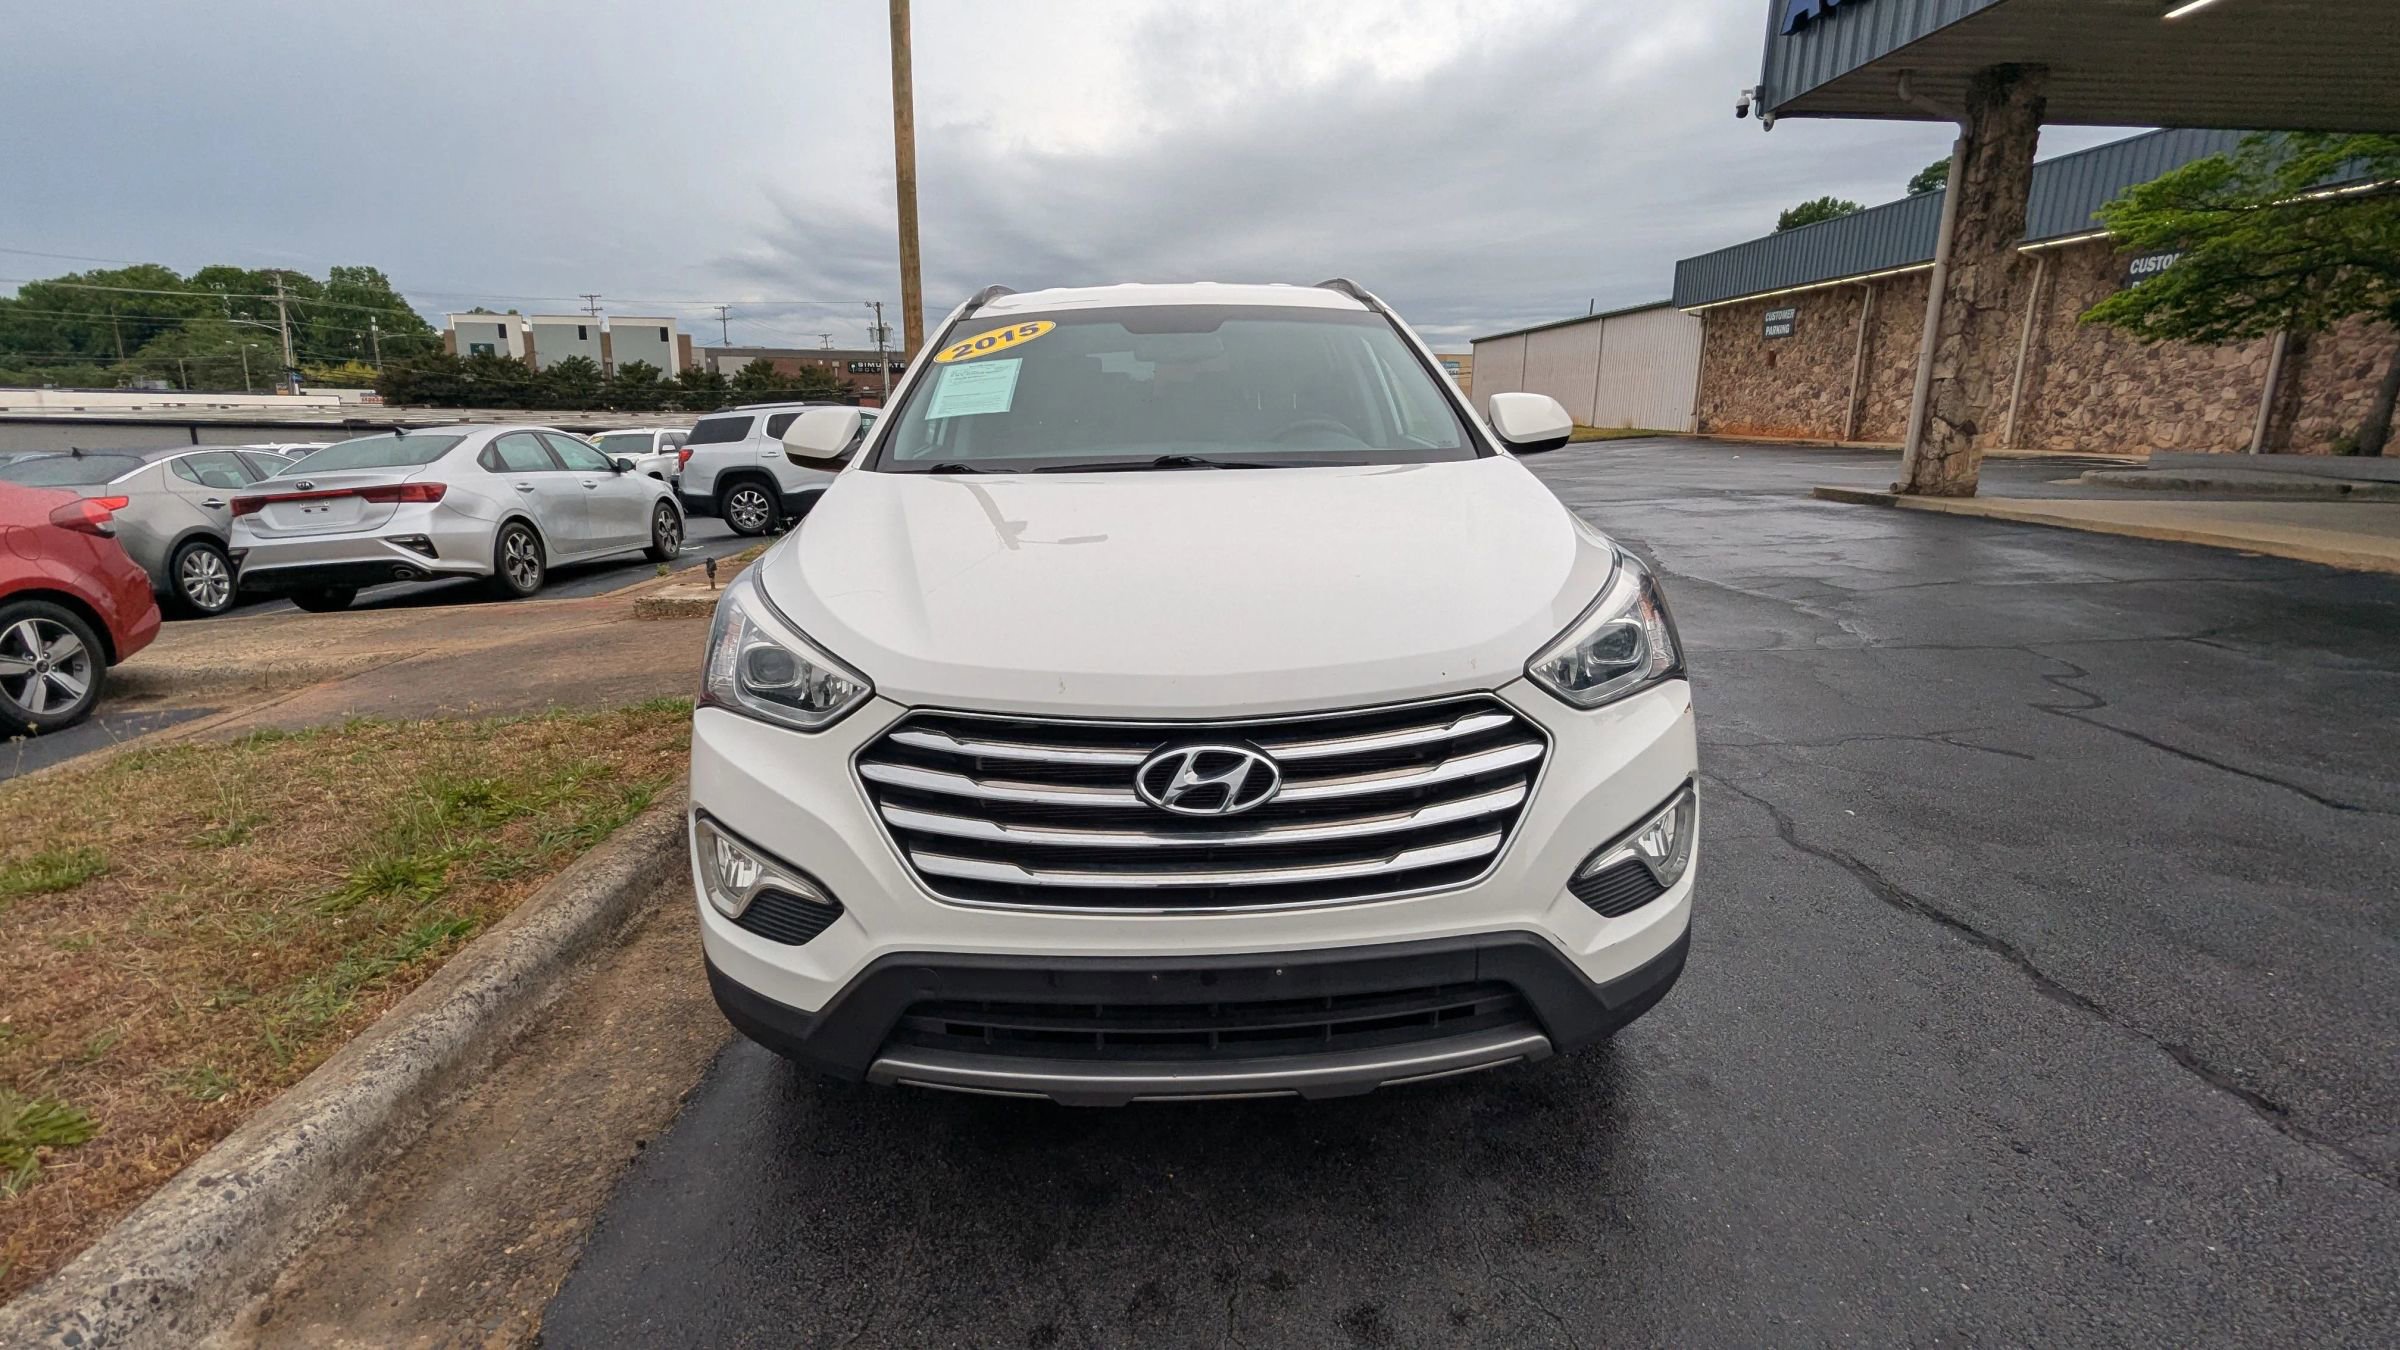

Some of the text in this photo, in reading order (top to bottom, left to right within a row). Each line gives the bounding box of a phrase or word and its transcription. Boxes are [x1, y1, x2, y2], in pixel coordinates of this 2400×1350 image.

[1765, 308, 1796, 322] CUSTOMER
[1765, 324, 1790, 336] PARKING
[951, 323, 1040, 360] 2015
